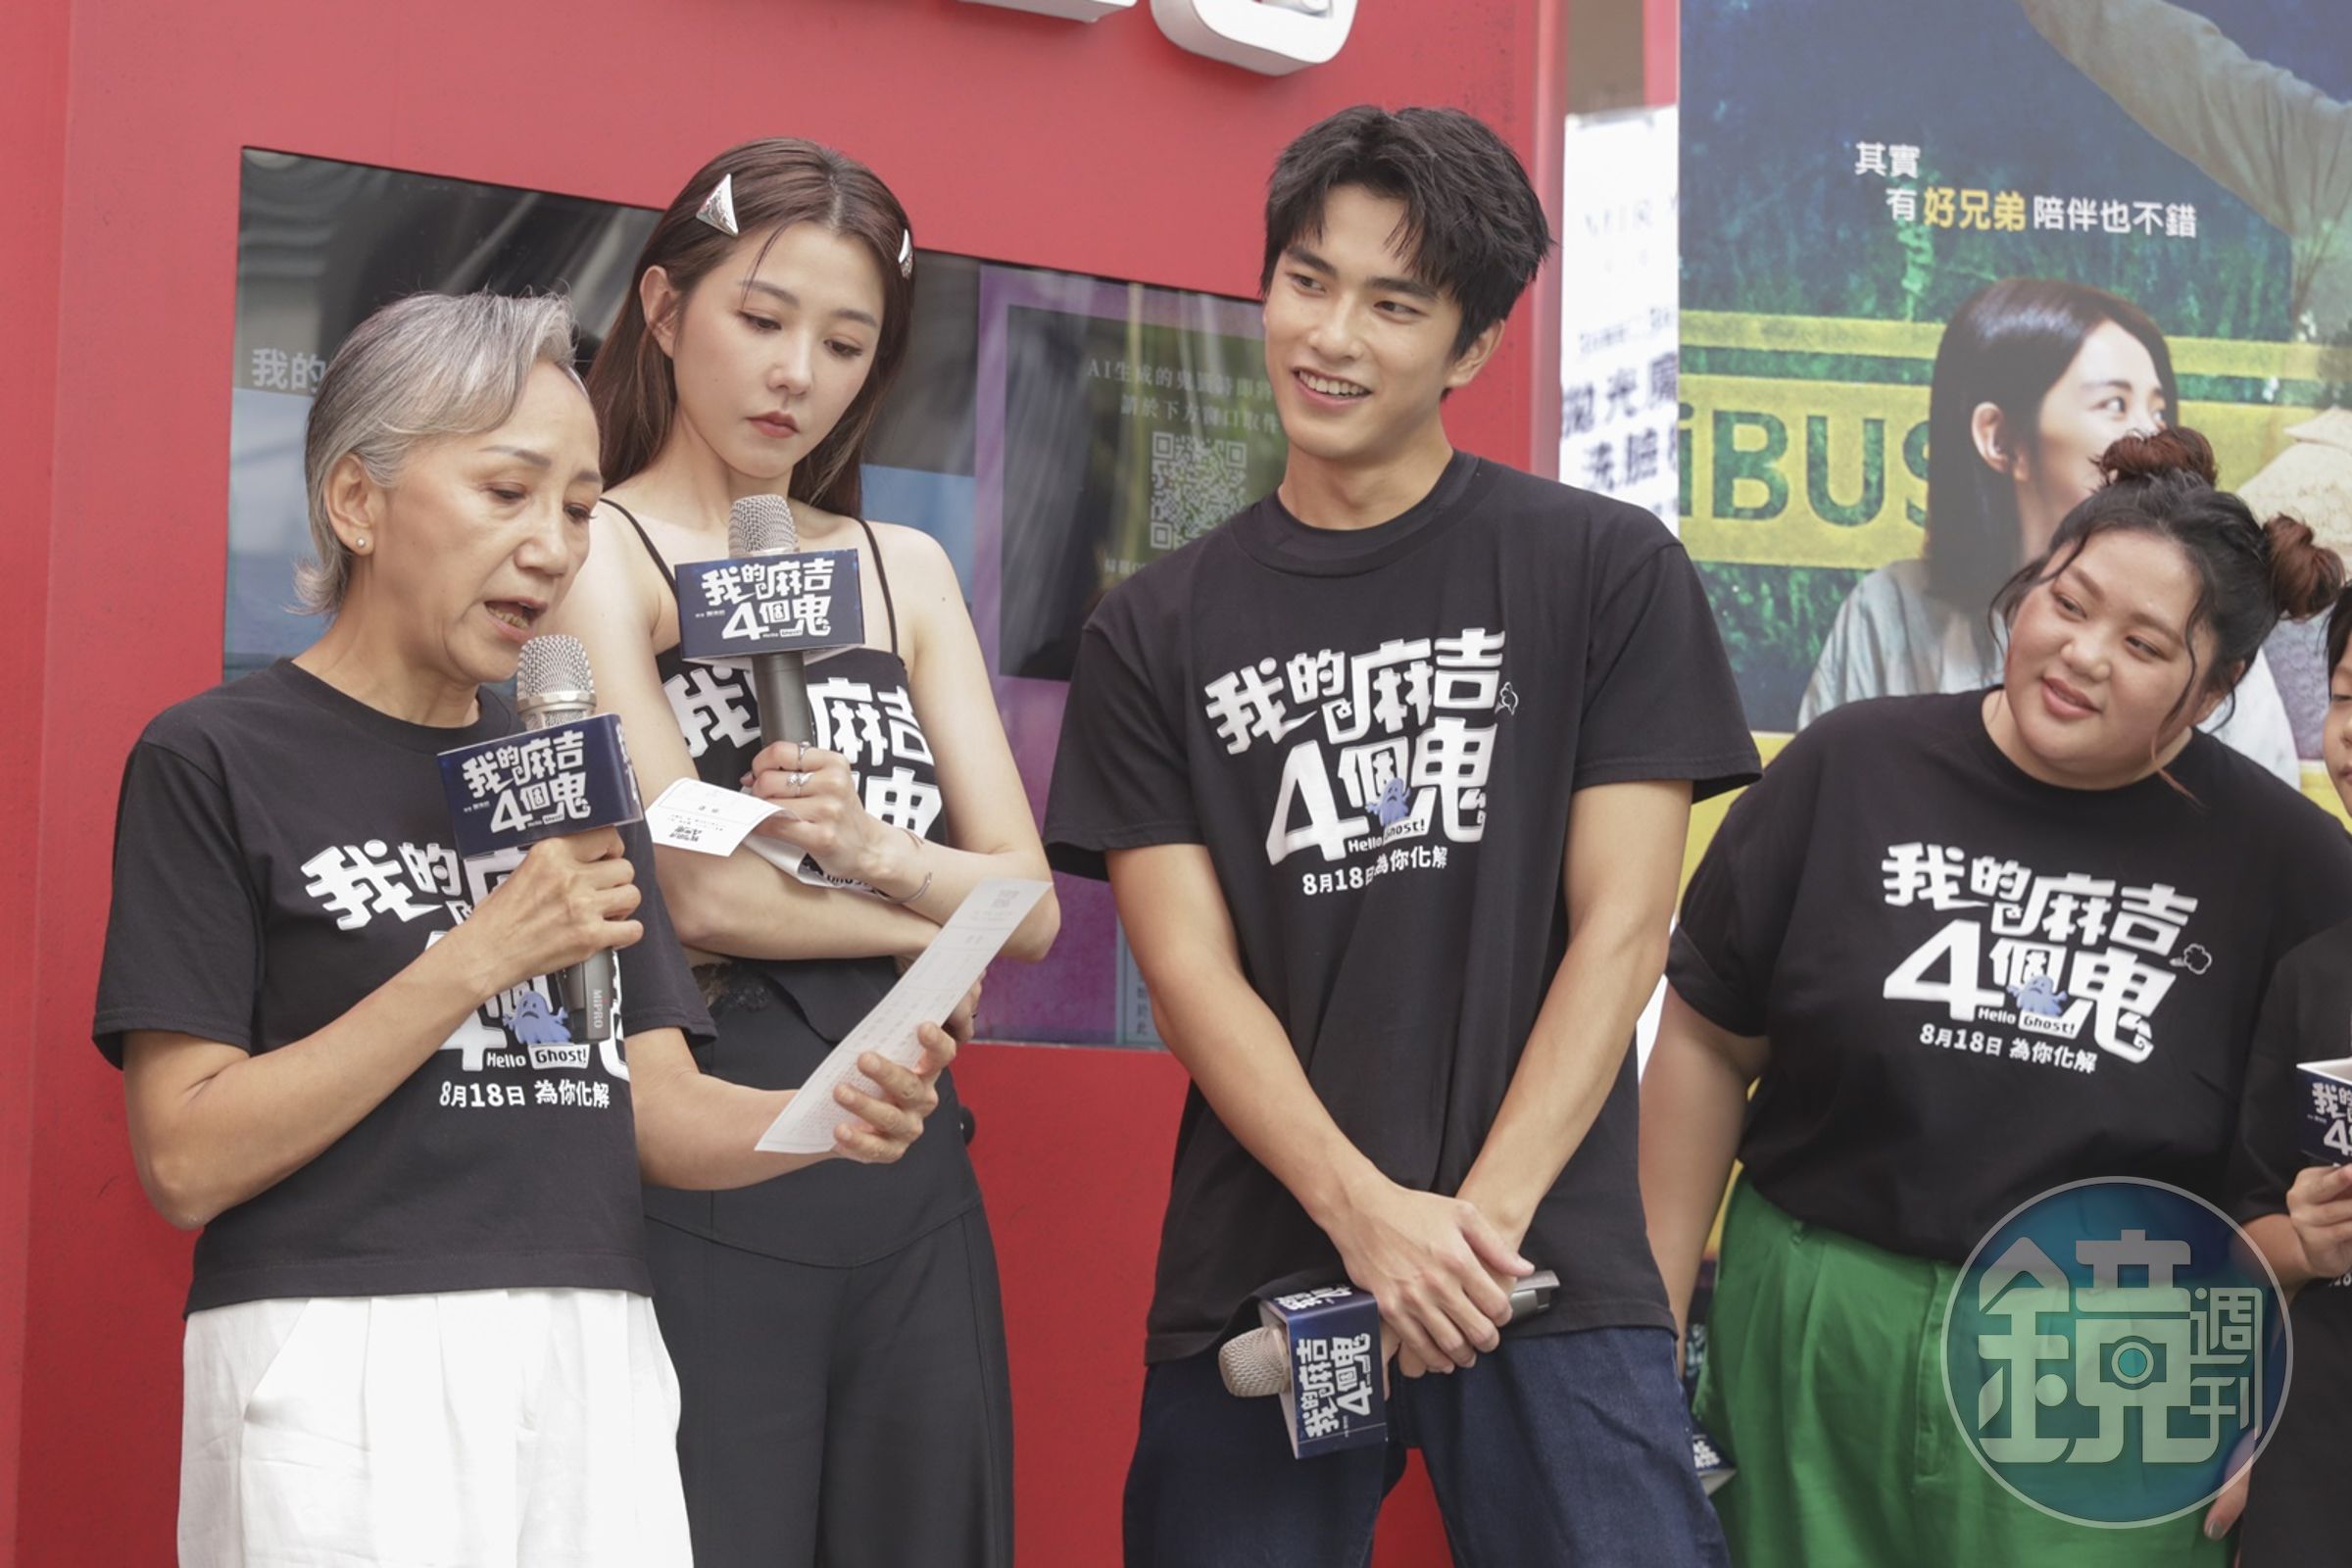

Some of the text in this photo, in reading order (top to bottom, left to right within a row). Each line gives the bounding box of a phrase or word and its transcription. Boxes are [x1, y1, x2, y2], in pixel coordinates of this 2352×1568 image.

[1855, 141, 1921, 178] 其實
[702, 558, 835, 606] 我的麻吉
[721, 594, 832, 640] 4個鬼
[1204, 627, 1505, 755] 我的麻吉
[462, 730, 584, 799] 我的麻吉
[1266, 716, 1497, 865] 4個鬼
[490, 771, 591, 833] 4個鬼
[1348, 836, 1383, 854] Hello
[1882, 842, 2197, 956] 我的麻吉
[1883, 919, 2176, 1063] 4個鬼
[1919, 1023, 2098, 1074] 8月18日 為你化解
[1978, 1007, 2077, 1035] Hello Ghost!
[486, 1048, 588, 1069] Hello Ghost!
[439, 1079, 611, 1108] 8月18日 為你化解
[1297, 1338, 1339, 1438] 我的麻吉
[1330, 1333, 1373, 1416] 4個鬼
